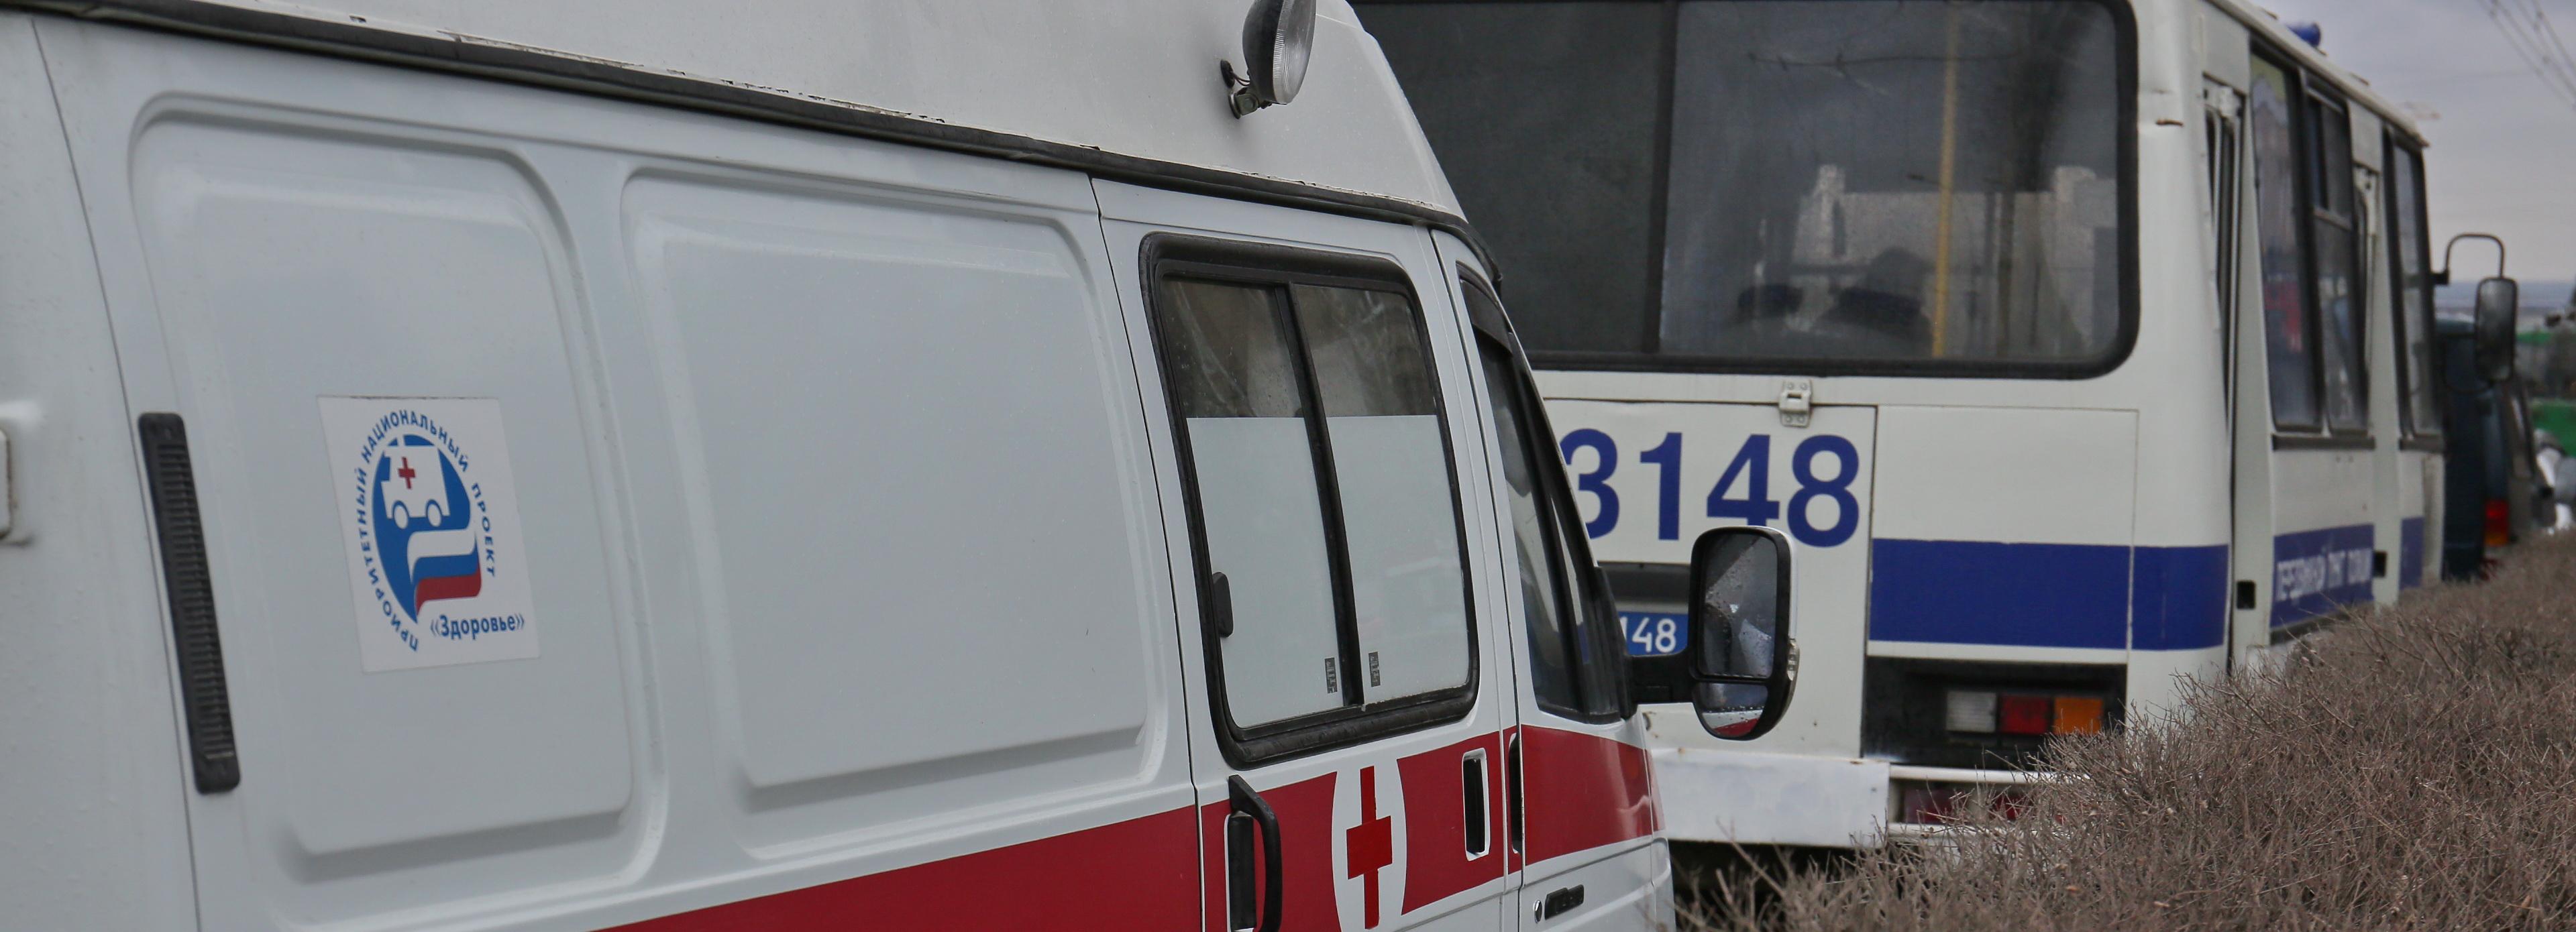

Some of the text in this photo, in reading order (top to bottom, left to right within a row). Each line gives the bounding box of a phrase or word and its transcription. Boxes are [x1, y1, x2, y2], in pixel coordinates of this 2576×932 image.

[354, 410, 495, 652] ПРИОРИТЕТНЫЙ НАЦИОНАЛЬНЫЙ ПРОЕКТ
[1559, 428, 1860, 548] 3148
[430, 614, 525, 640] «Здоровье»
